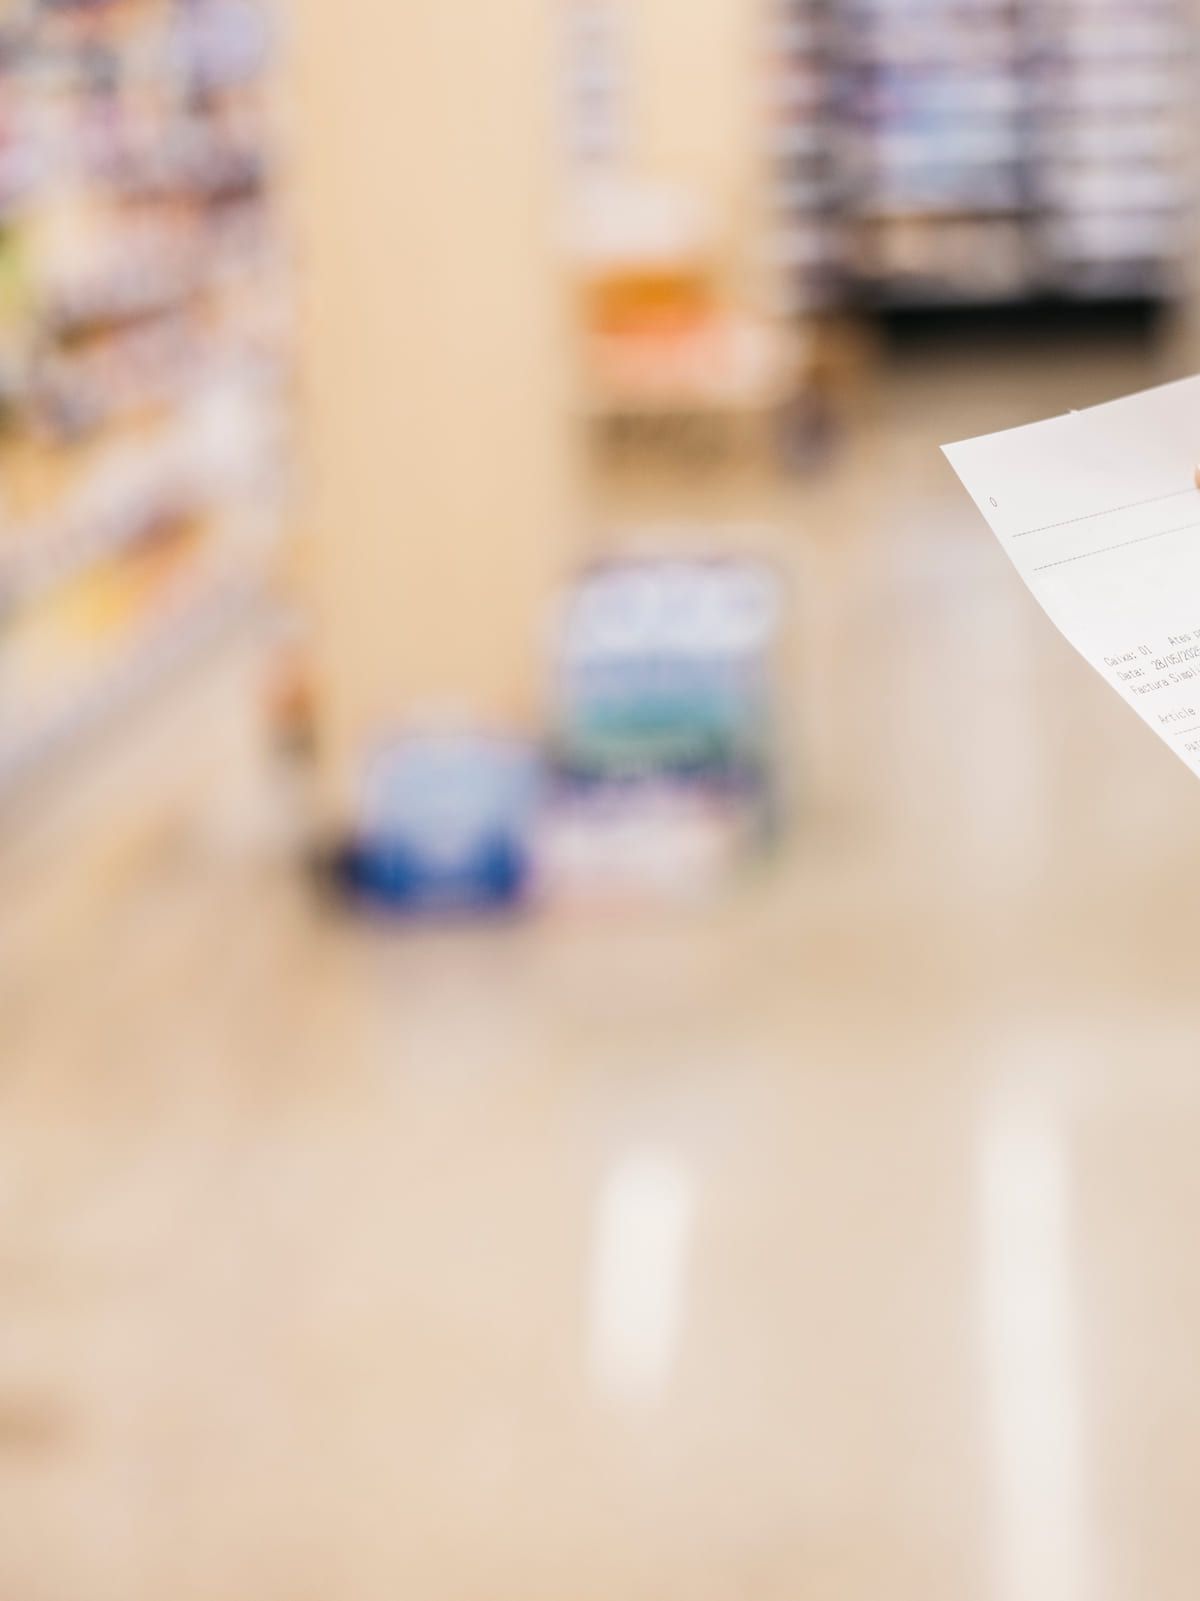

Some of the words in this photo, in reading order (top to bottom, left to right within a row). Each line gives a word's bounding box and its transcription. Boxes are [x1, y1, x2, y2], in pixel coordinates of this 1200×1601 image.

[1104, 651, 1137, 667] Caixa:
[1139, 645, 1153, 657] 01
[1117, 668, 1145, 681] Data:
[1130, 678, 1169, 696] Factura
[1157, 705, 1196, 724] Article
